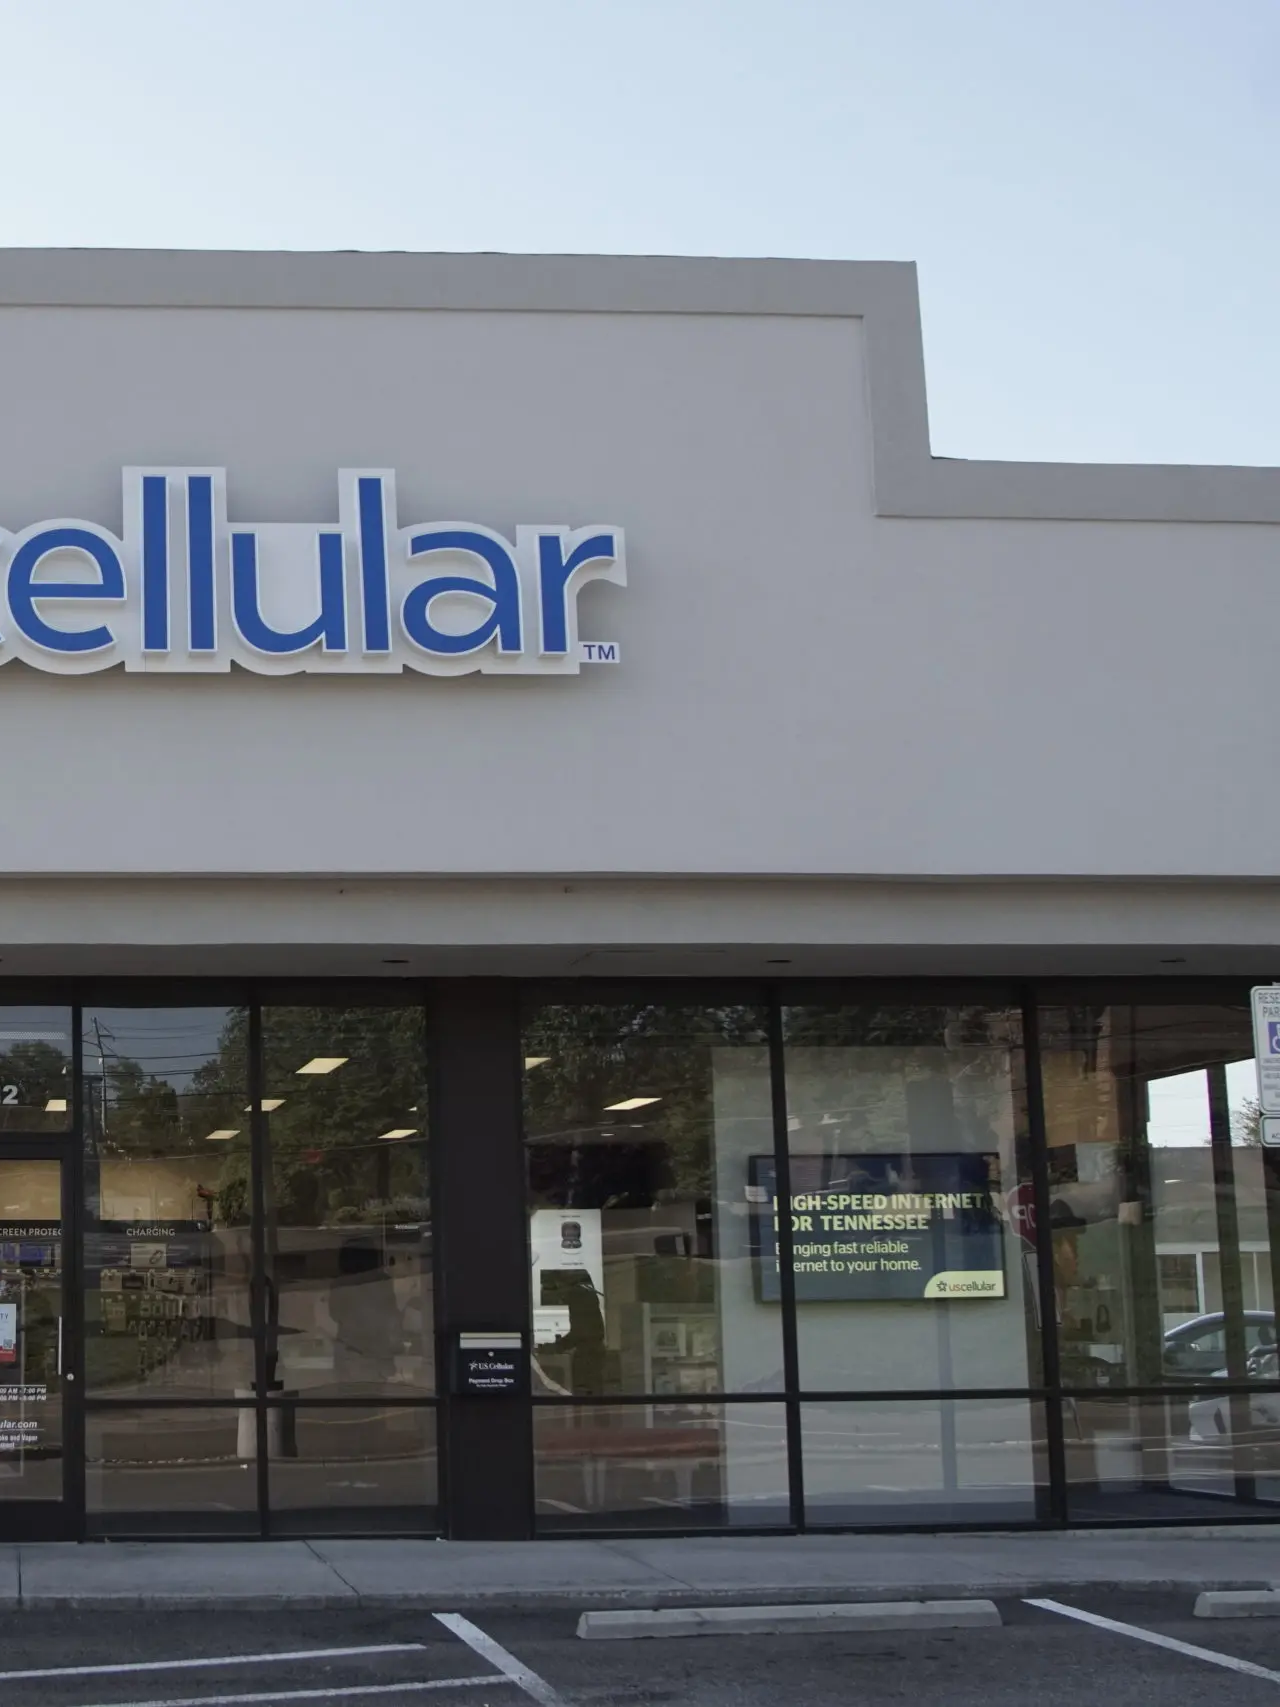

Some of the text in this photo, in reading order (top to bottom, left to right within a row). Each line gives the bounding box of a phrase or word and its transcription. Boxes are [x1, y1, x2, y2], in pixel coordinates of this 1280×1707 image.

[583, 644, 615, 660] TM
[773, 1192, 985, 1212] IGH-SPEED INTERNET
[819, 1213, 929, 1231] TENNESSEE
[126, 1227, 176, 1237] CHARGING
[775, 1240, 909, 1257] nging fast reliable
[775, 1257, 922, 1274] iernet to your home.
[948, 1280, 996, 1292] uscellular
